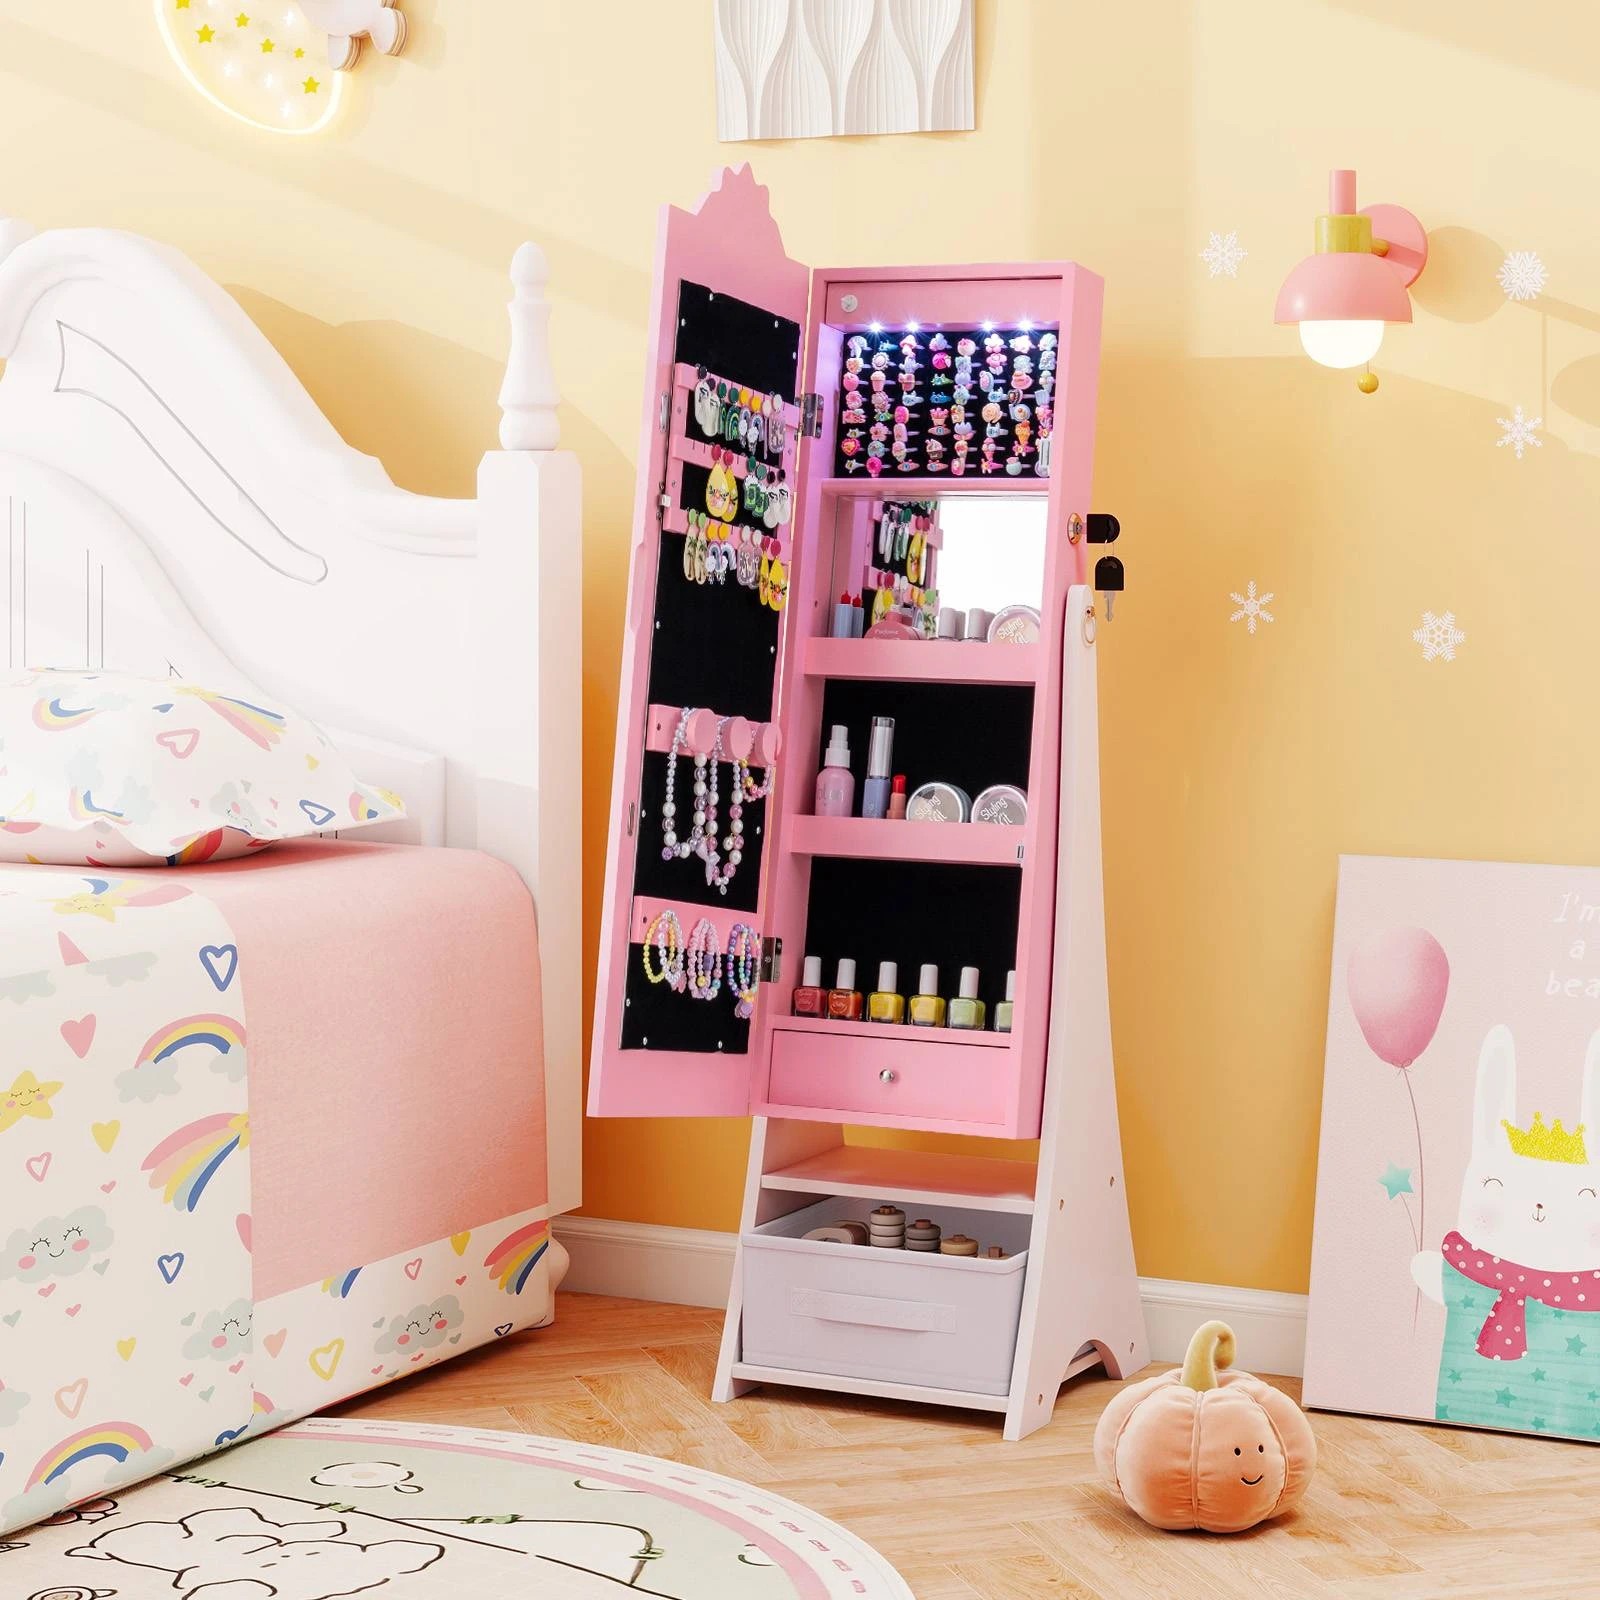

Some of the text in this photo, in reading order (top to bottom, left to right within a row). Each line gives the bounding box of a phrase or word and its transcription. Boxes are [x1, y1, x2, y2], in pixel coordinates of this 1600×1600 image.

[997, 617, 1024, 640] Styling
[915, 795, 941, 819] Styling
[980, 798, 1008, 820] Styling
[1569, 939, 1585, 960] a
